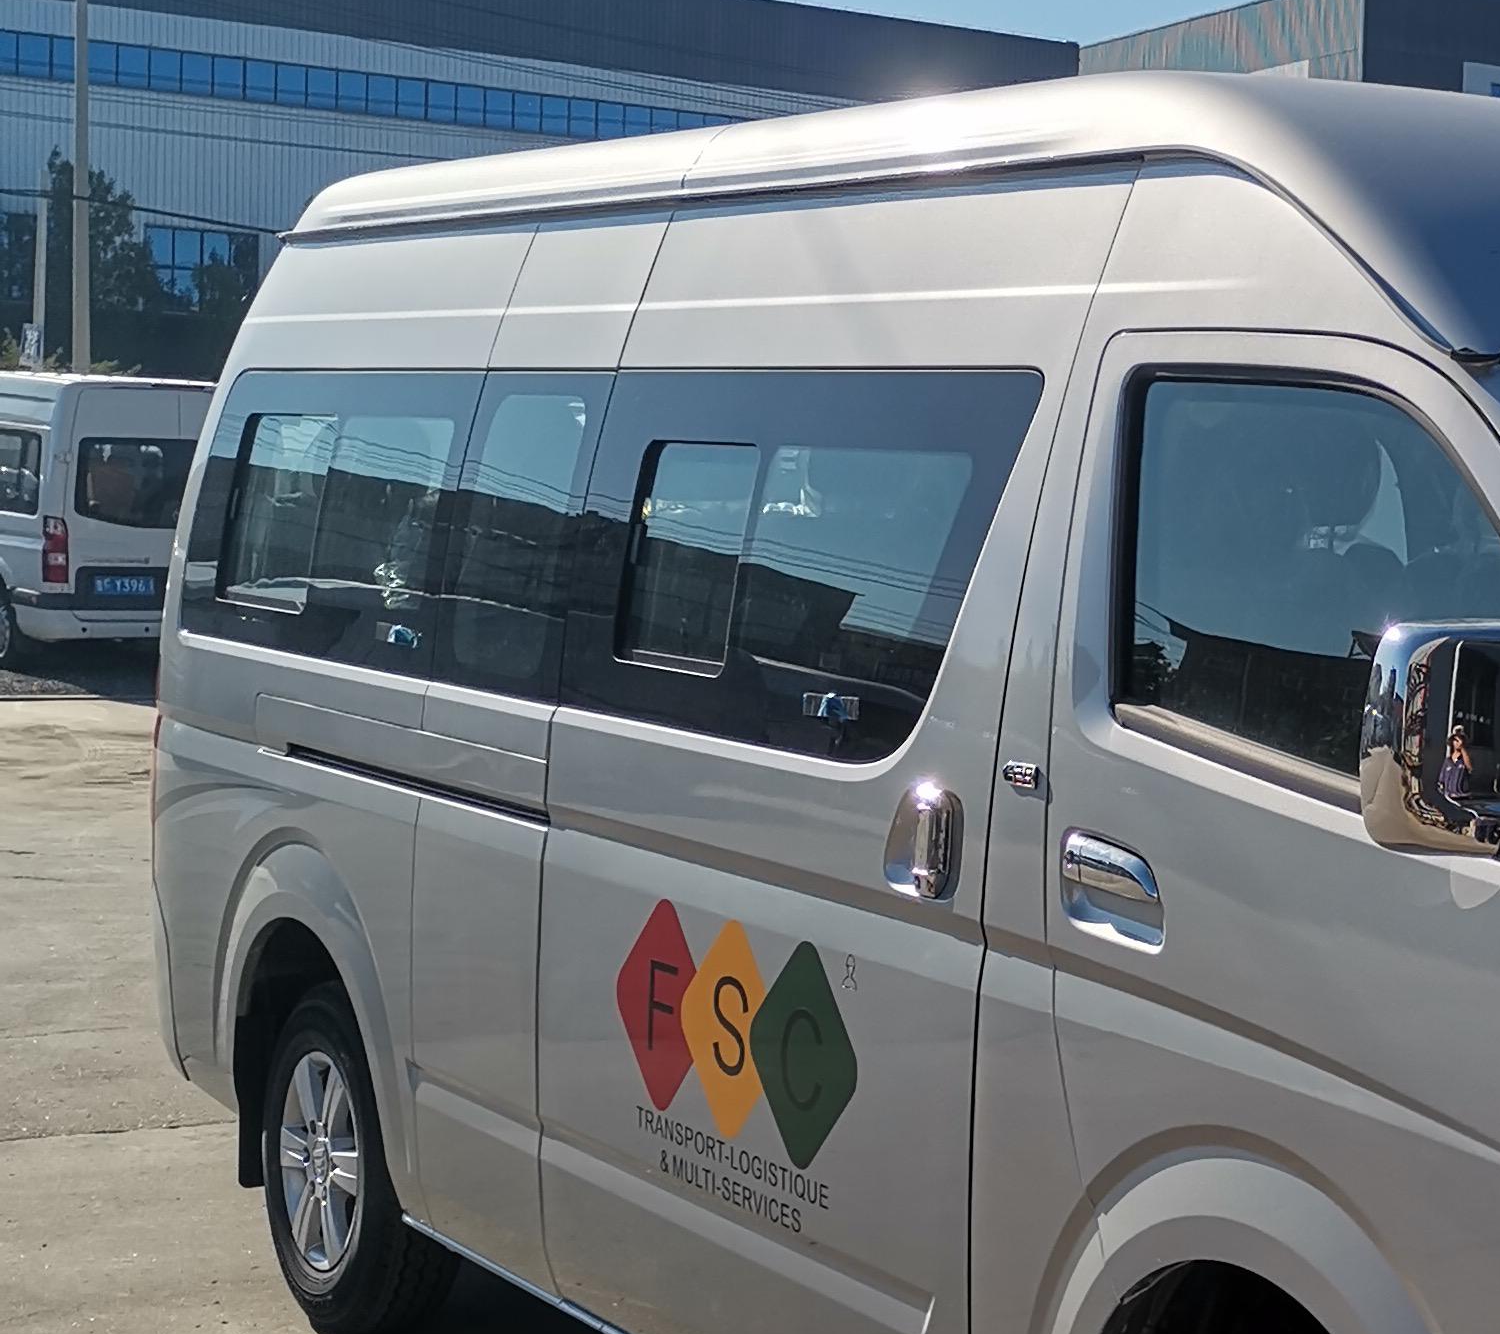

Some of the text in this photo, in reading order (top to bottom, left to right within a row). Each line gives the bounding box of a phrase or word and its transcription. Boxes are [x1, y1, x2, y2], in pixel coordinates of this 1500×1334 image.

[636, 1105, 830, 1210] TRANSPORT-LOGISTIQUE
[659, 1149, 802, 1234] & MULTI-SERVICES
